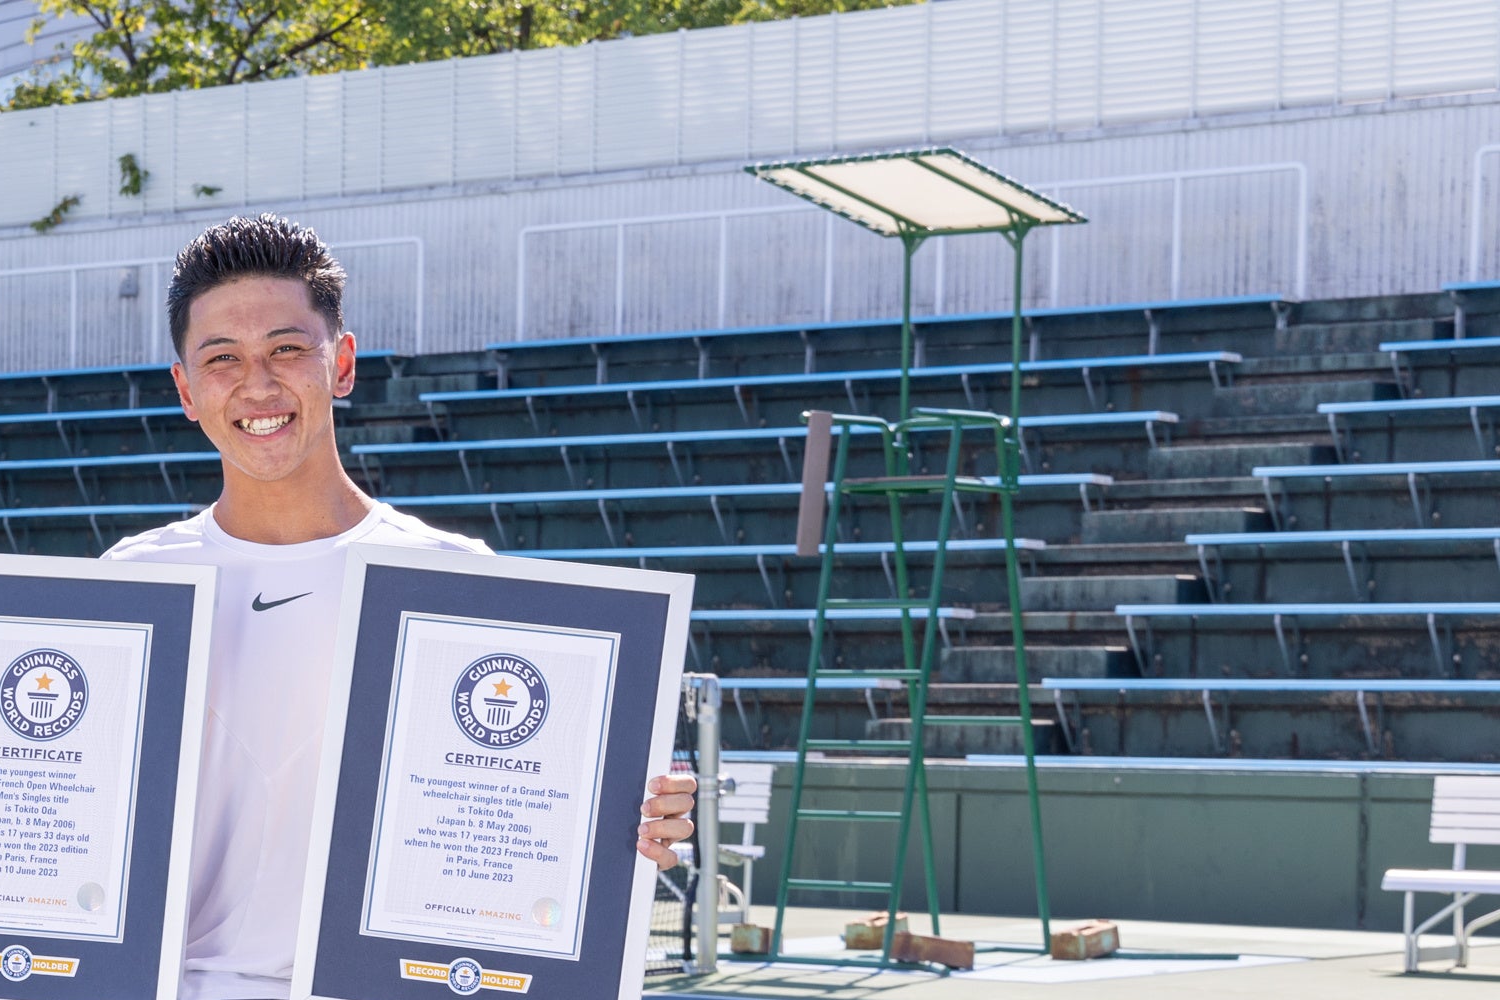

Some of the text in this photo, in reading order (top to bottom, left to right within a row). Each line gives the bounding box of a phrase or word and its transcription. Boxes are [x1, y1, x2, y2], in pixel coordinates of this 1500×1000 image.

[13, 654, 79, 680] GUINNESS
[469, 659, 539, 687] GUINNESS
[3, 687, 84, 737] WORLD RECORDS
[457, 691, 544, 744] WORLD RECORDS
[445, 752, 542, 773] CERTIFICATE
[9, 769, 46, 779] youngest
[48, 772, 76, 780] winner
[26, 780, 47, 791] Open
[49, 782, 96, 793] Wheelchair
[410, 774, 425, 784] The
[427, 778, 466, 789] youngest
[468, 782, 499, 792] winner
[500, 784, 510, 793] of
[519, 786, 546, 797] Grand
[547, 789, 569, 800] Slam
[21, 792, 51, 803] Singles
[53, 795, 69, 804] title
[422, 789, 552, 812] wheelchair singles title (male)
[4, 803, 57, 815] is Tokito Oda
[4, 852, 27, 863] Paris,
[29, 854, 58, 865] France
[404, 838, 559, 862] when he won the 2023 French Open
[5, 865, 14, 874] 10
[16, 866, 36, 876] June
[38, 867, 58, 877] 2023
[27, 897, 67, 906] AMAZING
[33, 961, 69, 971] HOLDER
[409, 966, 521, 987] RECORD HOLDER
